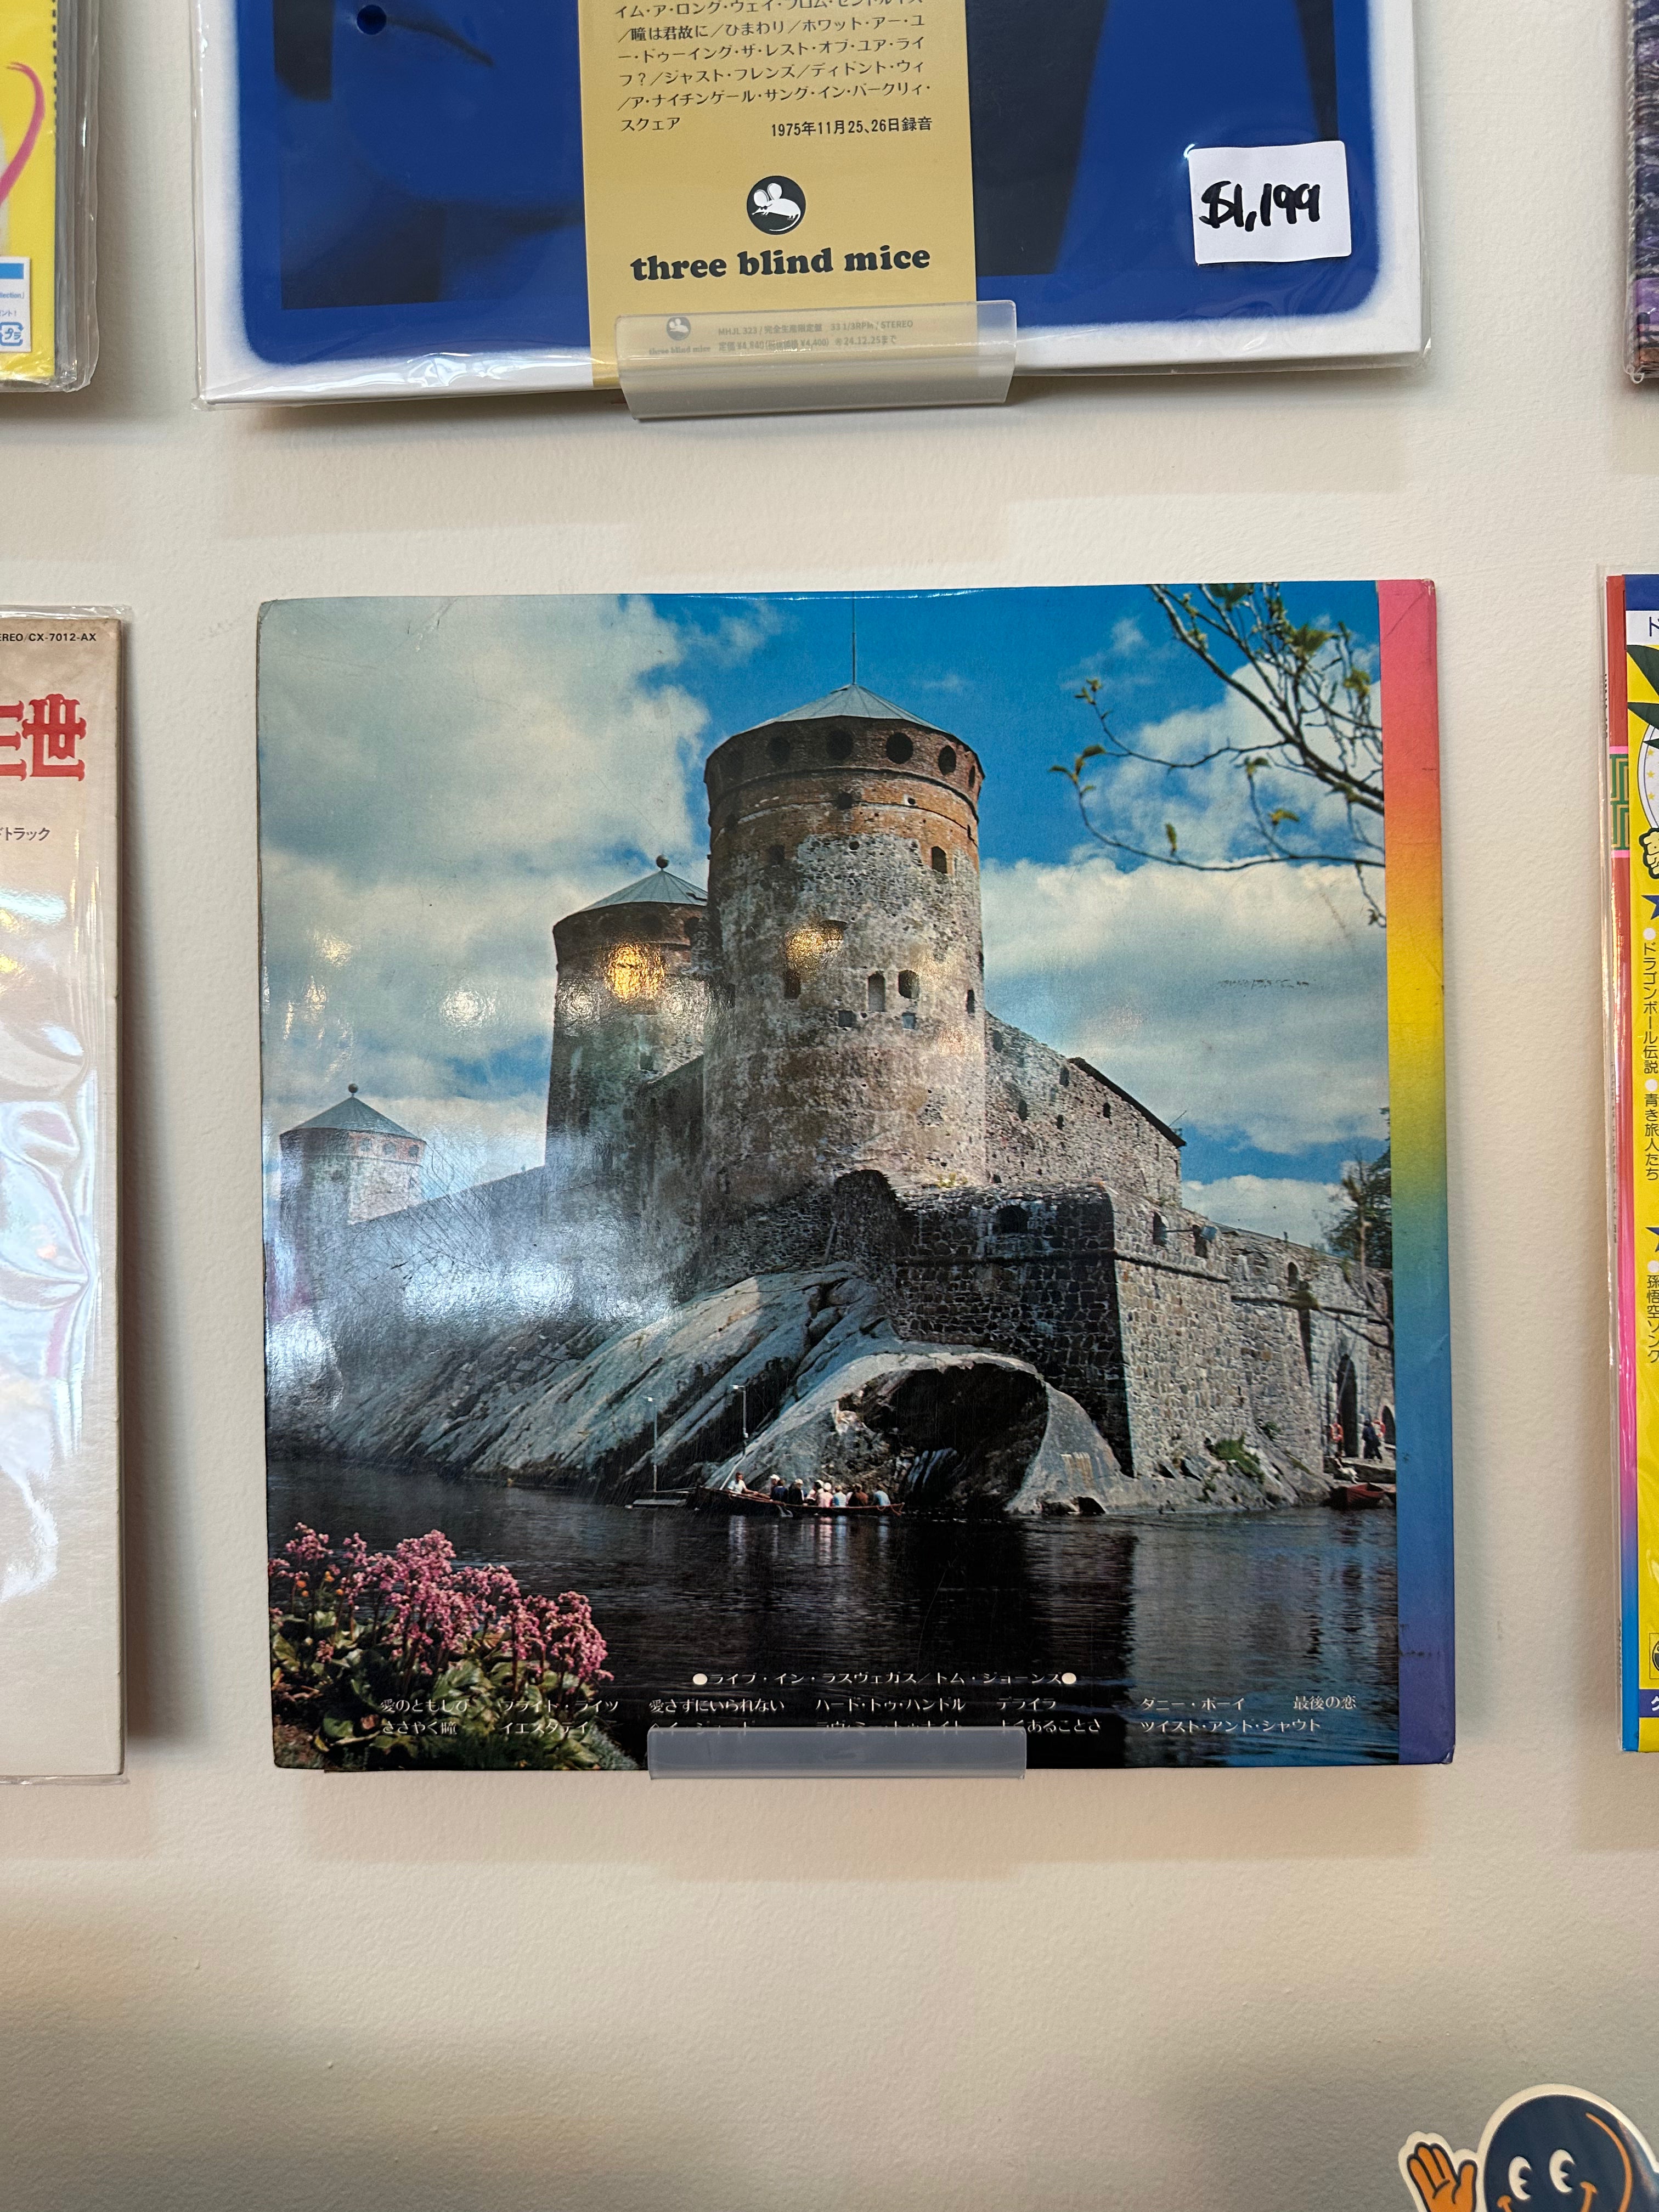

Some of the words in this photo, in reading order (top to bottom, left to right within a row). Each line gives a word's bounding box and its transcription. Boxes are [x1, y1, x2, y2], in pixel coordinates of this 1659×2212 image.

[771, 116, 933, 137] 1975年11月25、26日録音
[1198, 180, 1321, 232] $1,199
[630, 255, 727, 281] three
[737, 247, 833, 276] blind
[844, 245, 931, 272] mice
[881, 320, 913, 329] STEREO
[0, 827, 50, 841] トラック
[1643, 942, 1658, 1074] ドラゴンボール伝説
[1644, 1093, 1659, 1181] 青き旅人たち
[1293, 1695, 1357, 1711] 最後の恋
